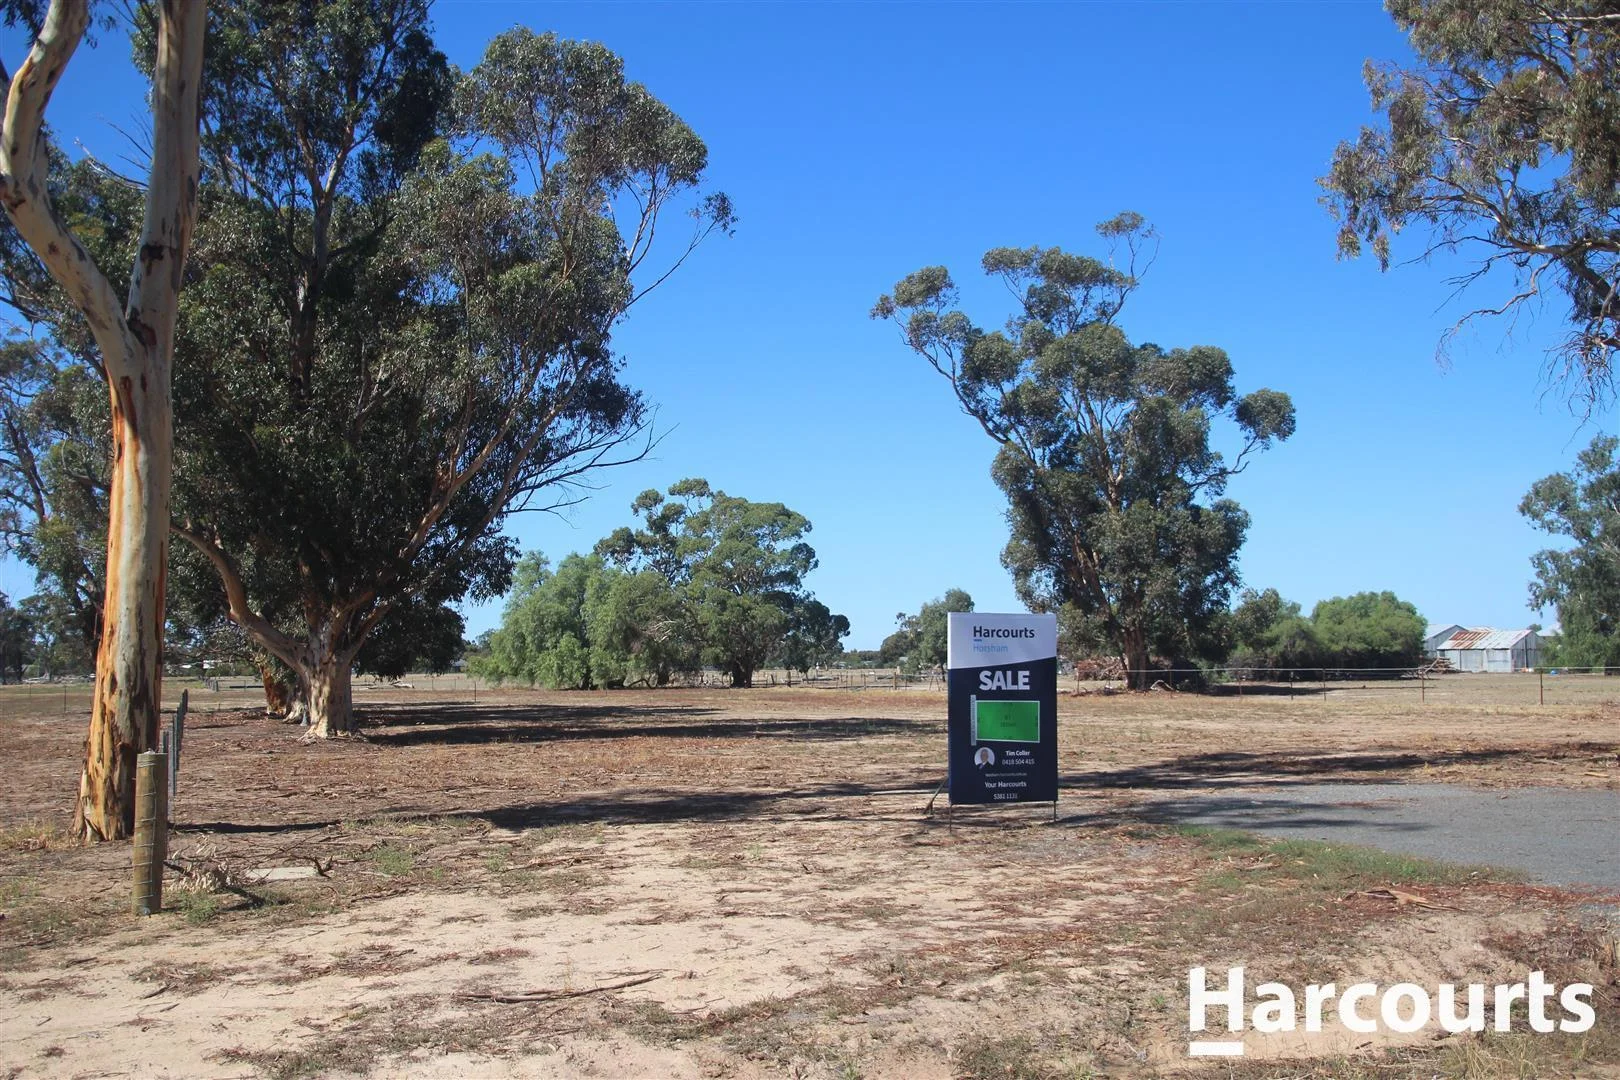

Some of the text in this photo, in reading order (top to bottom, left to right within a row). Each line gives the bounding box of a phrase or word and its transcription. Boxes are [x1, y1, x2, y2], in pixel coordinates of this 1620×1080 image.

[973, 625, 1035, 638] Harcourts
[973, 644, 1008, 652] Horsham
[979, 671, 1030, 690] SALE
